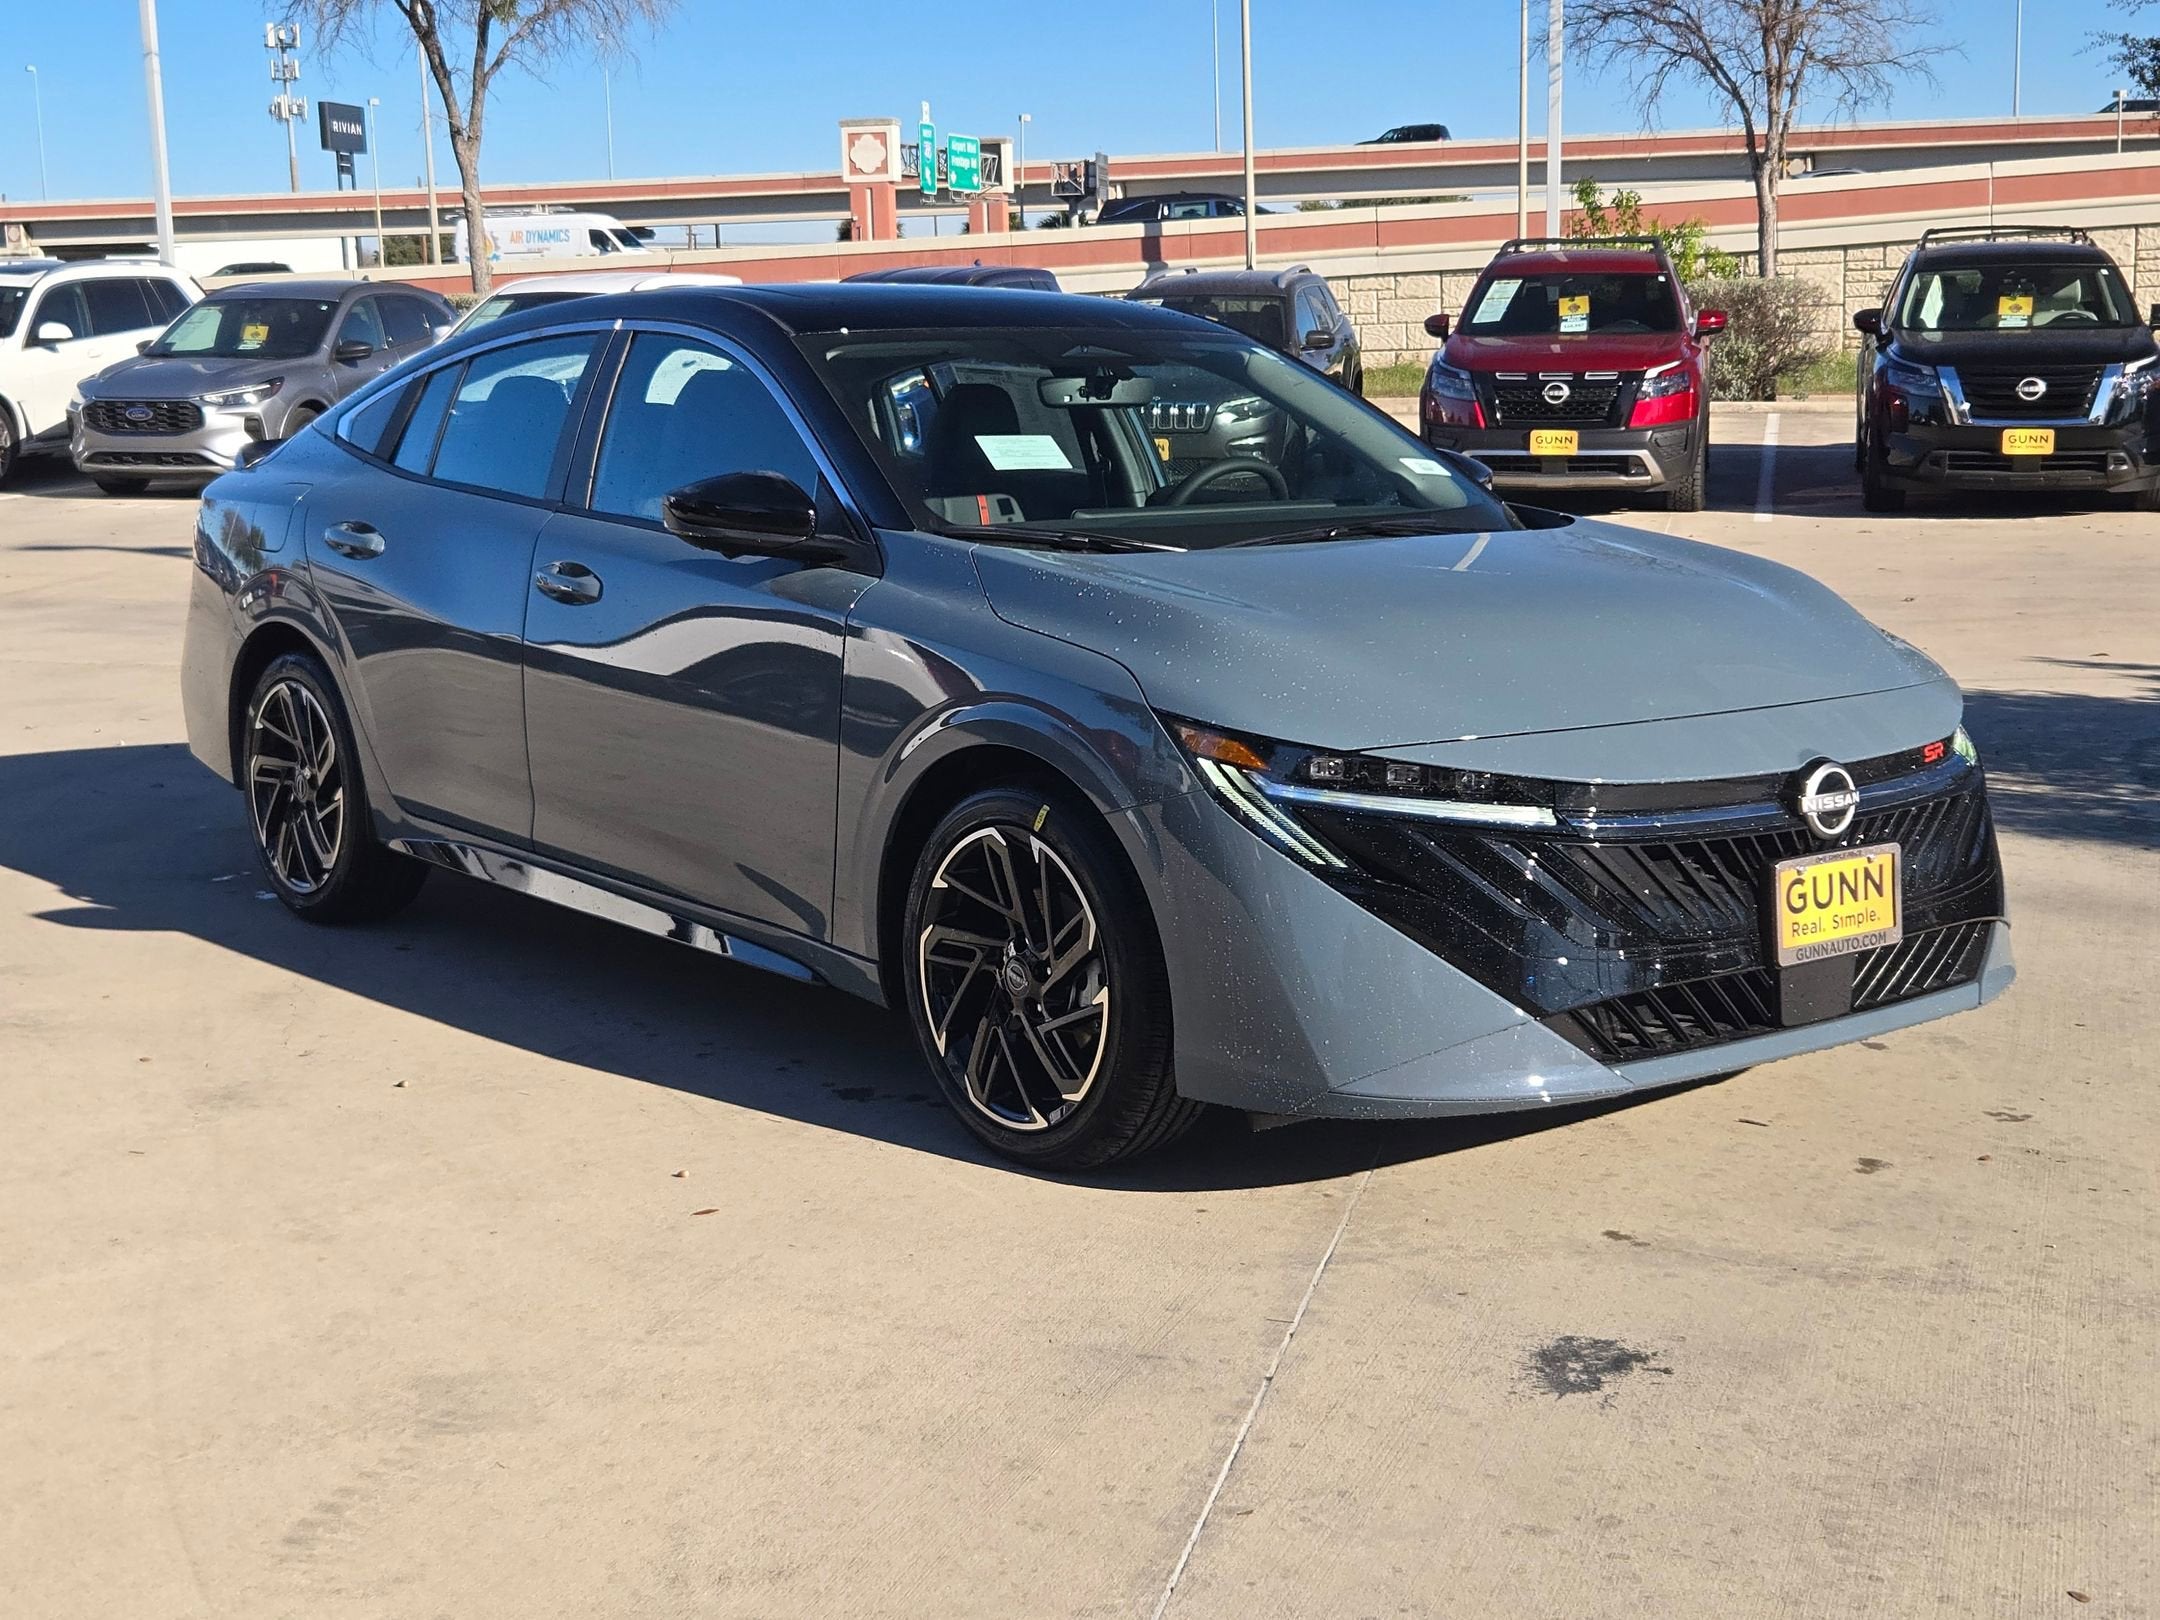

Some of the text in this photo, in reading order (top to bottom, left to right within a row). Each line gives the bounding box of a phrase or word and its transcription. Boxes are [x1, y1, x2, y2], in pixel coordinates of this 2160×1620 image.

[333, 121, 362, 135] RIVIAN
[510, 229, 570, 244] AIR DYNAMICS
[1535, 435, 1573, 445] GUNN
[2008, 435, 2048, 444] GUNN
[1923, 741, 1944, 763] SR
[1802, 791, 1860, 813] NISSAN
[1786, 864, 1884, 914] GUNN
[1792, 907, 1881, 938] Real. Simple.
[1796, 931, 1887, 961] GUNNAUTO.COM
